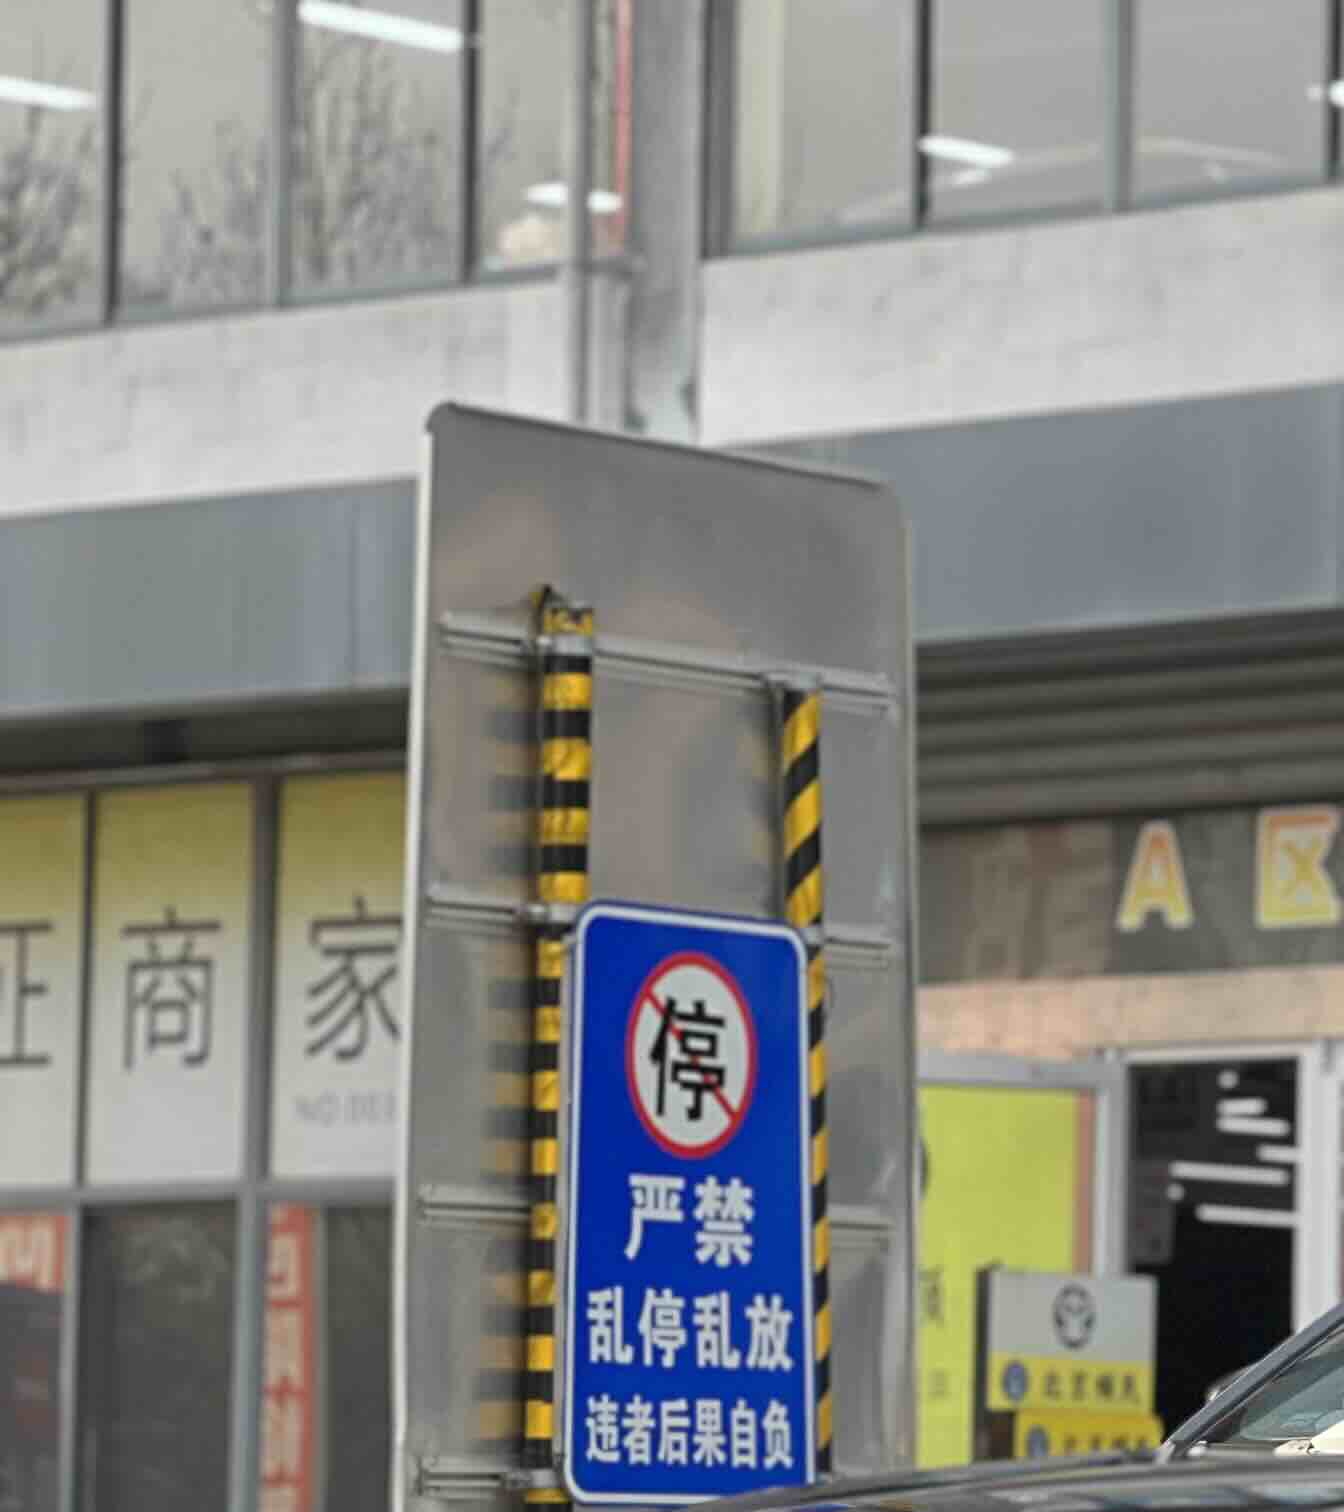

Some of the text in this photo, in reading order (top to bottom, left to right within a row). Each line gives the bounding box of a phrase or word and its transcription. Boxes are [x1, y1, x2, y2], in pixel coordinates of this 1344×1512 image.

[648, 996, 726, 1122] 停
[623, 1173, 755, 1269] 严禁
[585, 1286, 796, 1373] 乱停乱放
[584, 1393, 795, 1471] 违者后果自负
